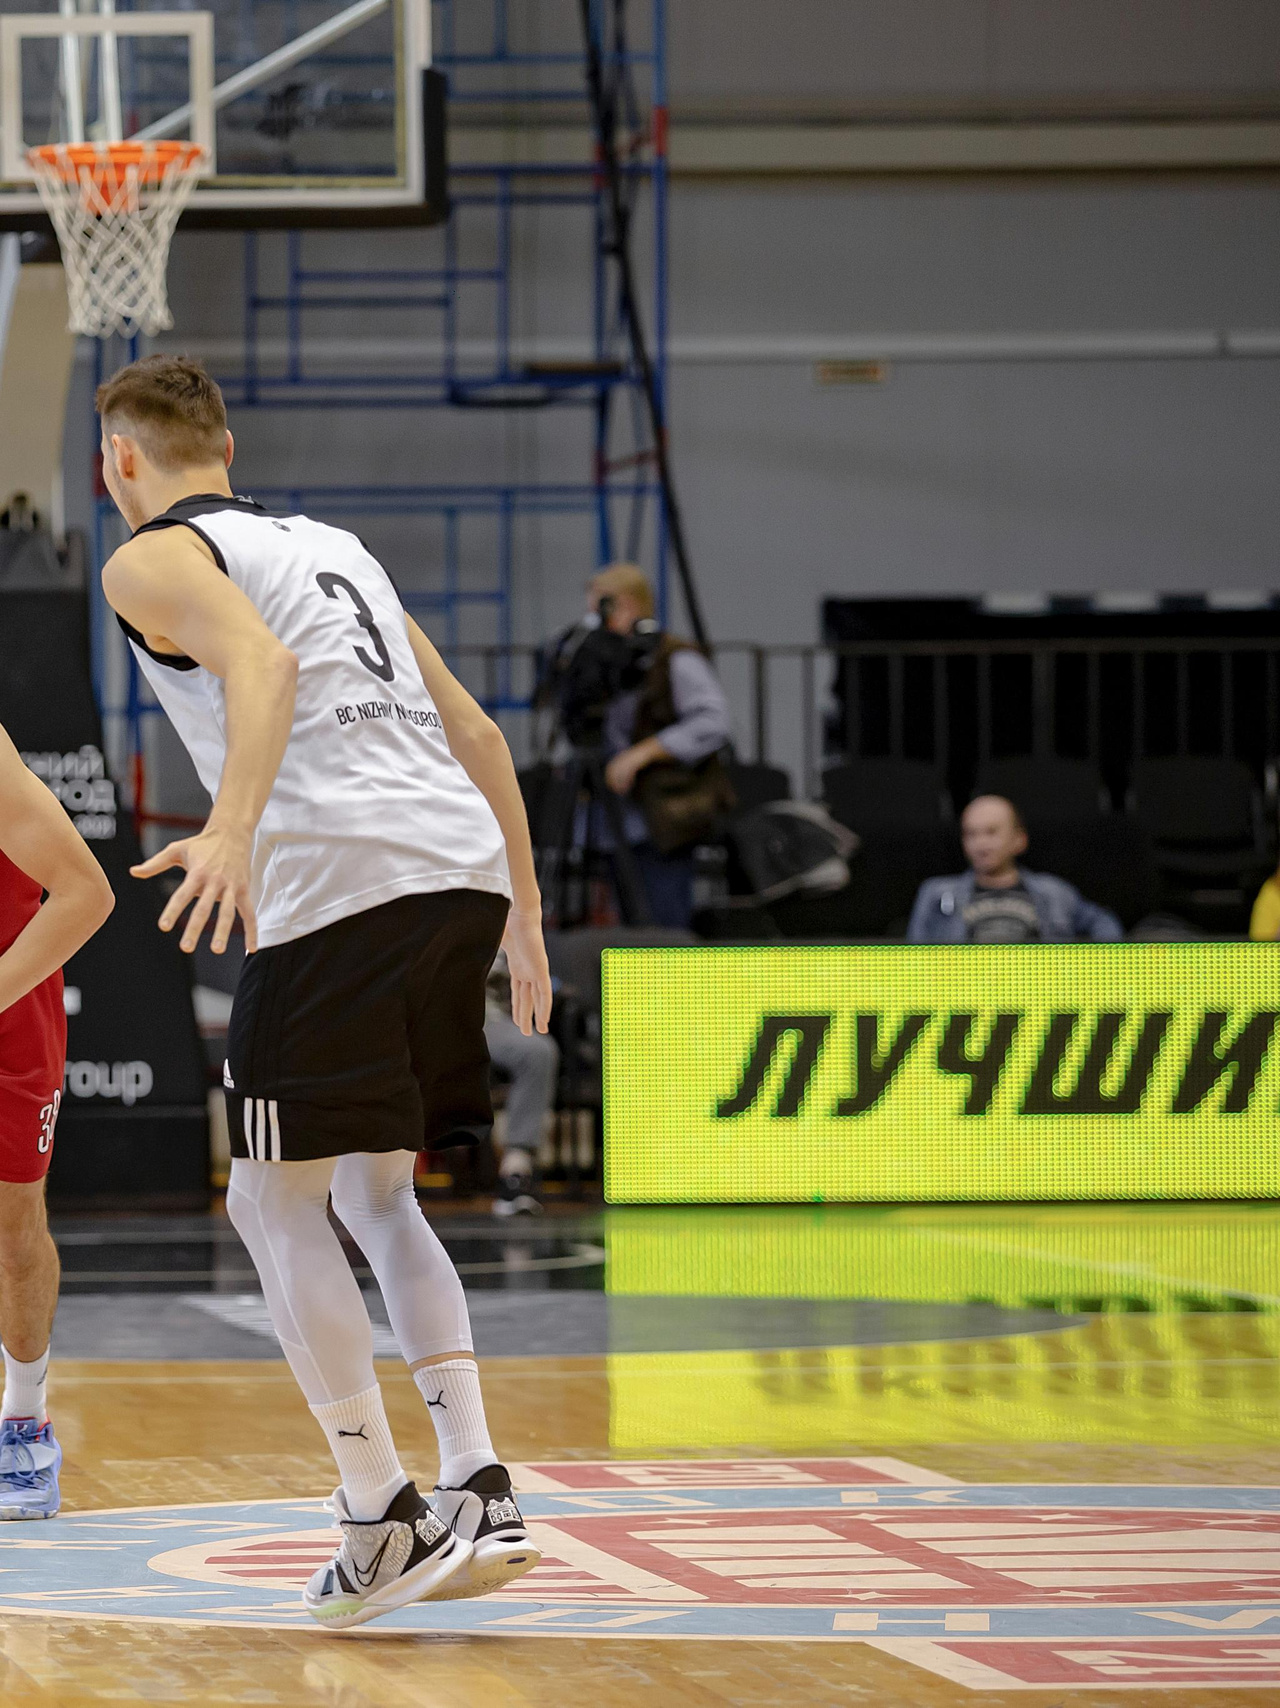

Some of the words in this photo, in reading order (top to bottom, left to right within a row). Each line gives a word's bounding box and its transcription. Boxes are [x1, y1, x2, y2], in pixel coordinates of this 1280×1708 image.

[316, 571, 395, 682] 3
[335, 705, 356, 726] BC
[62, 1060, 154, 1106] roup
